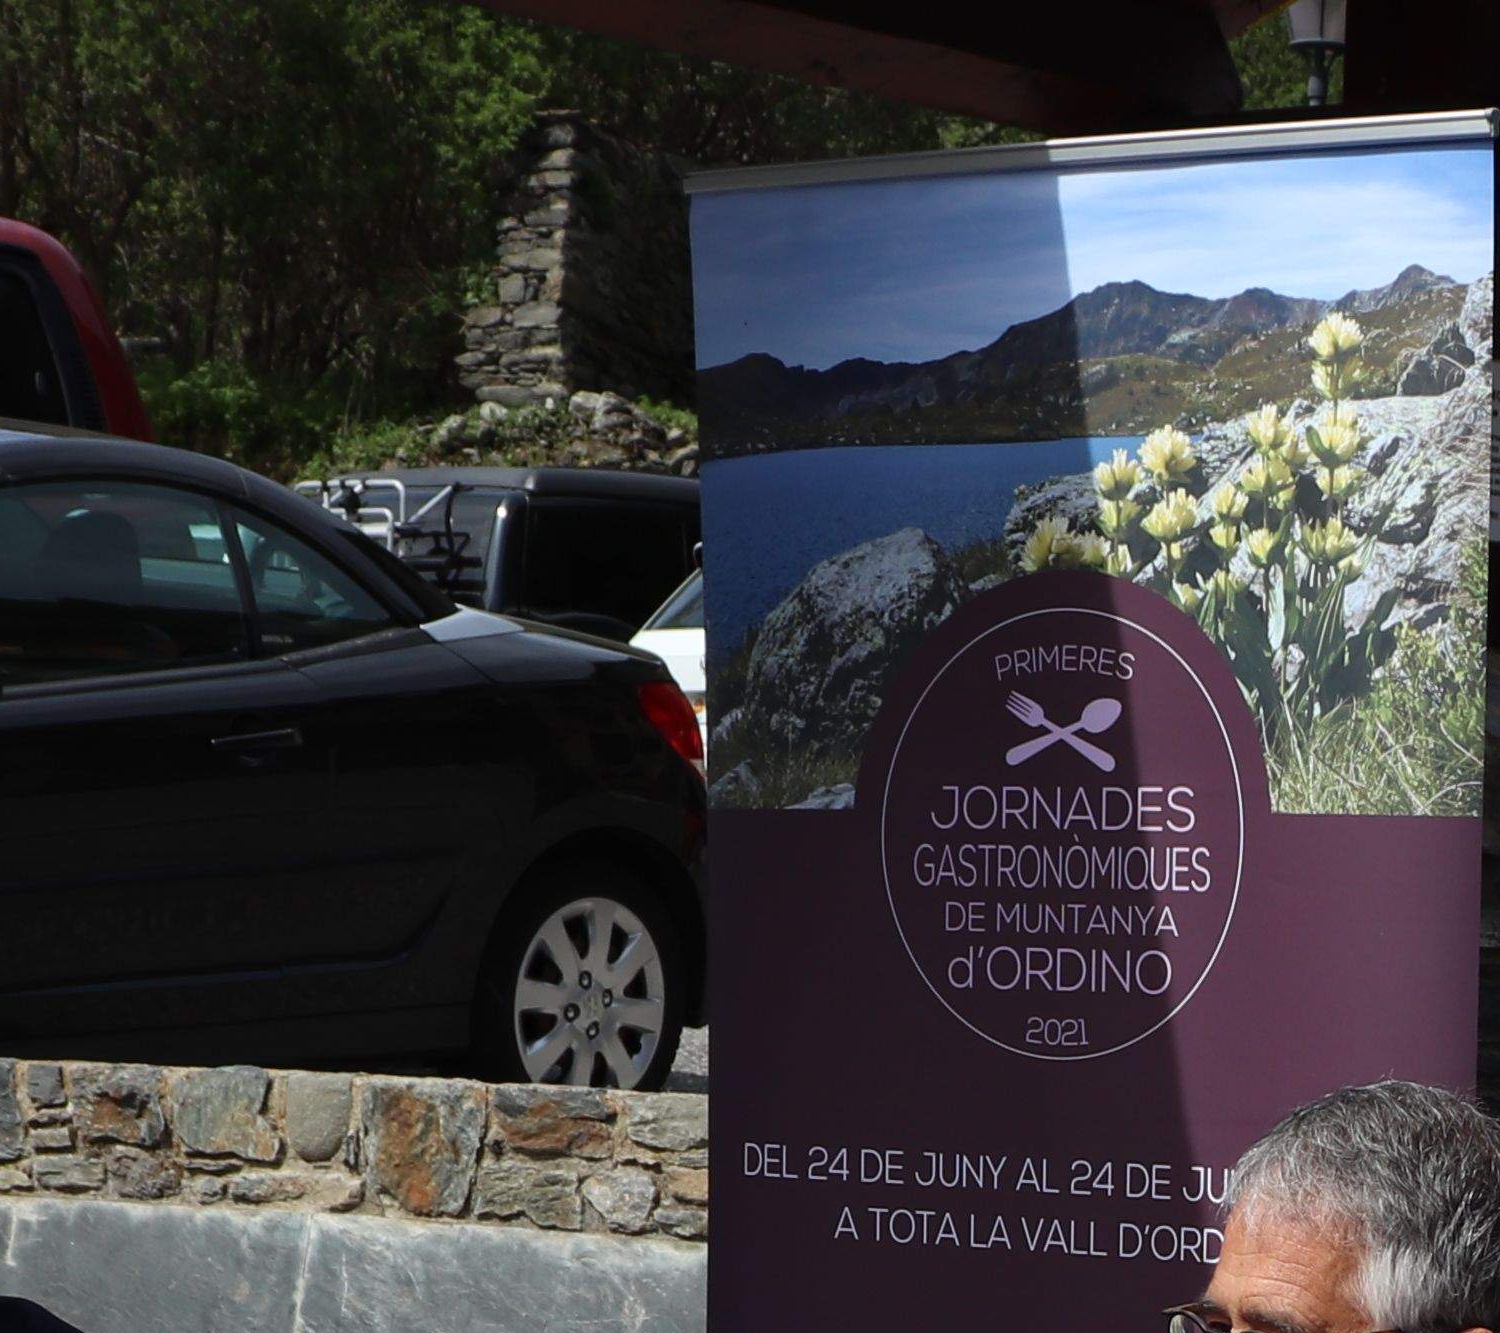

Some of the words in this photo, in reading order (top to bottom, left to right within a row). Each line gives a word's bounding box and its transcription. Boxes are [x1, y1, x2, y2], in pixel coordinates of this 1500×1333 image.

[994, 646, 1135, 681] PRIMERES
[930, 785, 1196, 833] JORNADES
[913, 834, 1211, 894] GASTRONÒMIQUES
[945, 901, 986, 934] DE
[996, 903, 1179, 939] MUNTANYA
[948, 946, 1172, 996] d'ORDINO
[1025, 1016, 1090, 1048] 2021
[743, 1143, 799, 1180] DEL
[807, 1145, 850, 1181] 24
[860, 1148, 905, 1185] DE
[913, 1152, 1005, 1191] JUNY
[1016, 1157, 1059, 1193] AL
[1070, 1160, 1116, 1198] 24
[1125, 1164, 1172, 1200] DE
[1182, 1166, 1234, 1202] JU
[834, 1207, 860, 1239] A
[868, 1207, 958, 1246] TOTA
[970, 1214, 1012, 1249] LA
[1020, 1218, 1106, 1258] VALL
